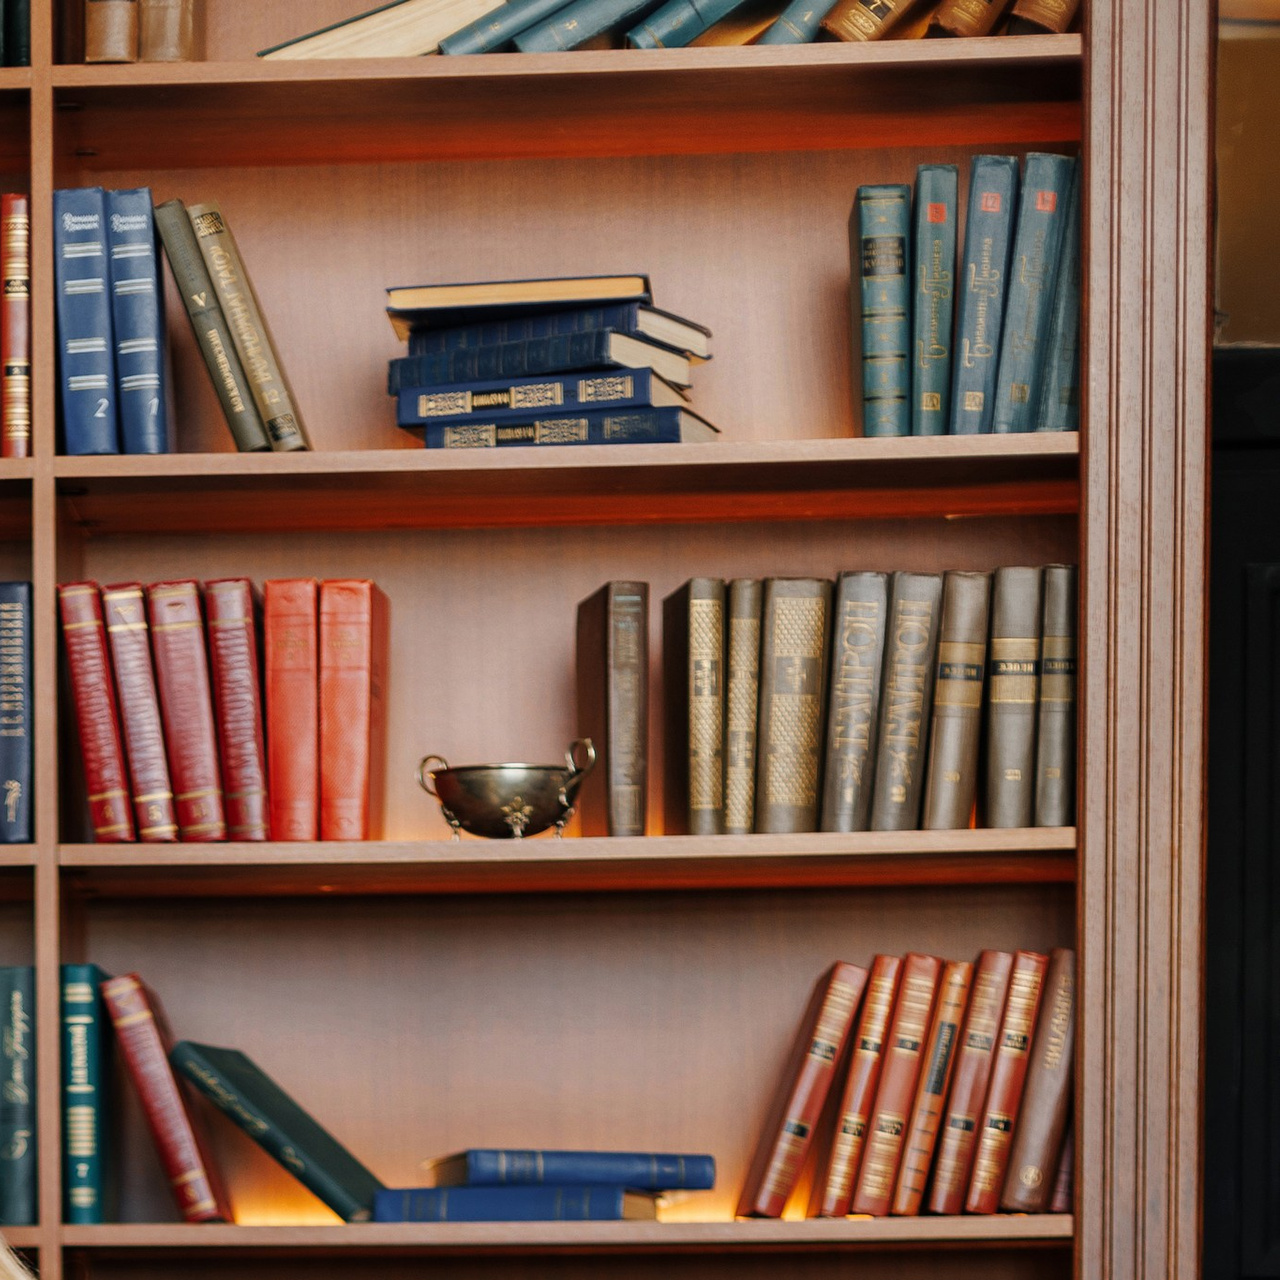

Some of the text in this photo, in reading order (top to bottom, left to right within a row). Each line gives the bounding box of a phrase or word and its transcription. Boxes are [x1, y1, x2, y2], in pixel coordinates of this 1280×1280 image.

[921, 239, 950, 299] Пионера
[963, 237, 999, 368] Библиотека Пионера
[93, 398, 109, 417] 2
[148, 398, 159, 416] 1
[834, 601, 879, 750] БАЙРОН
[885, 599, 932, 748] БАЙРОН
